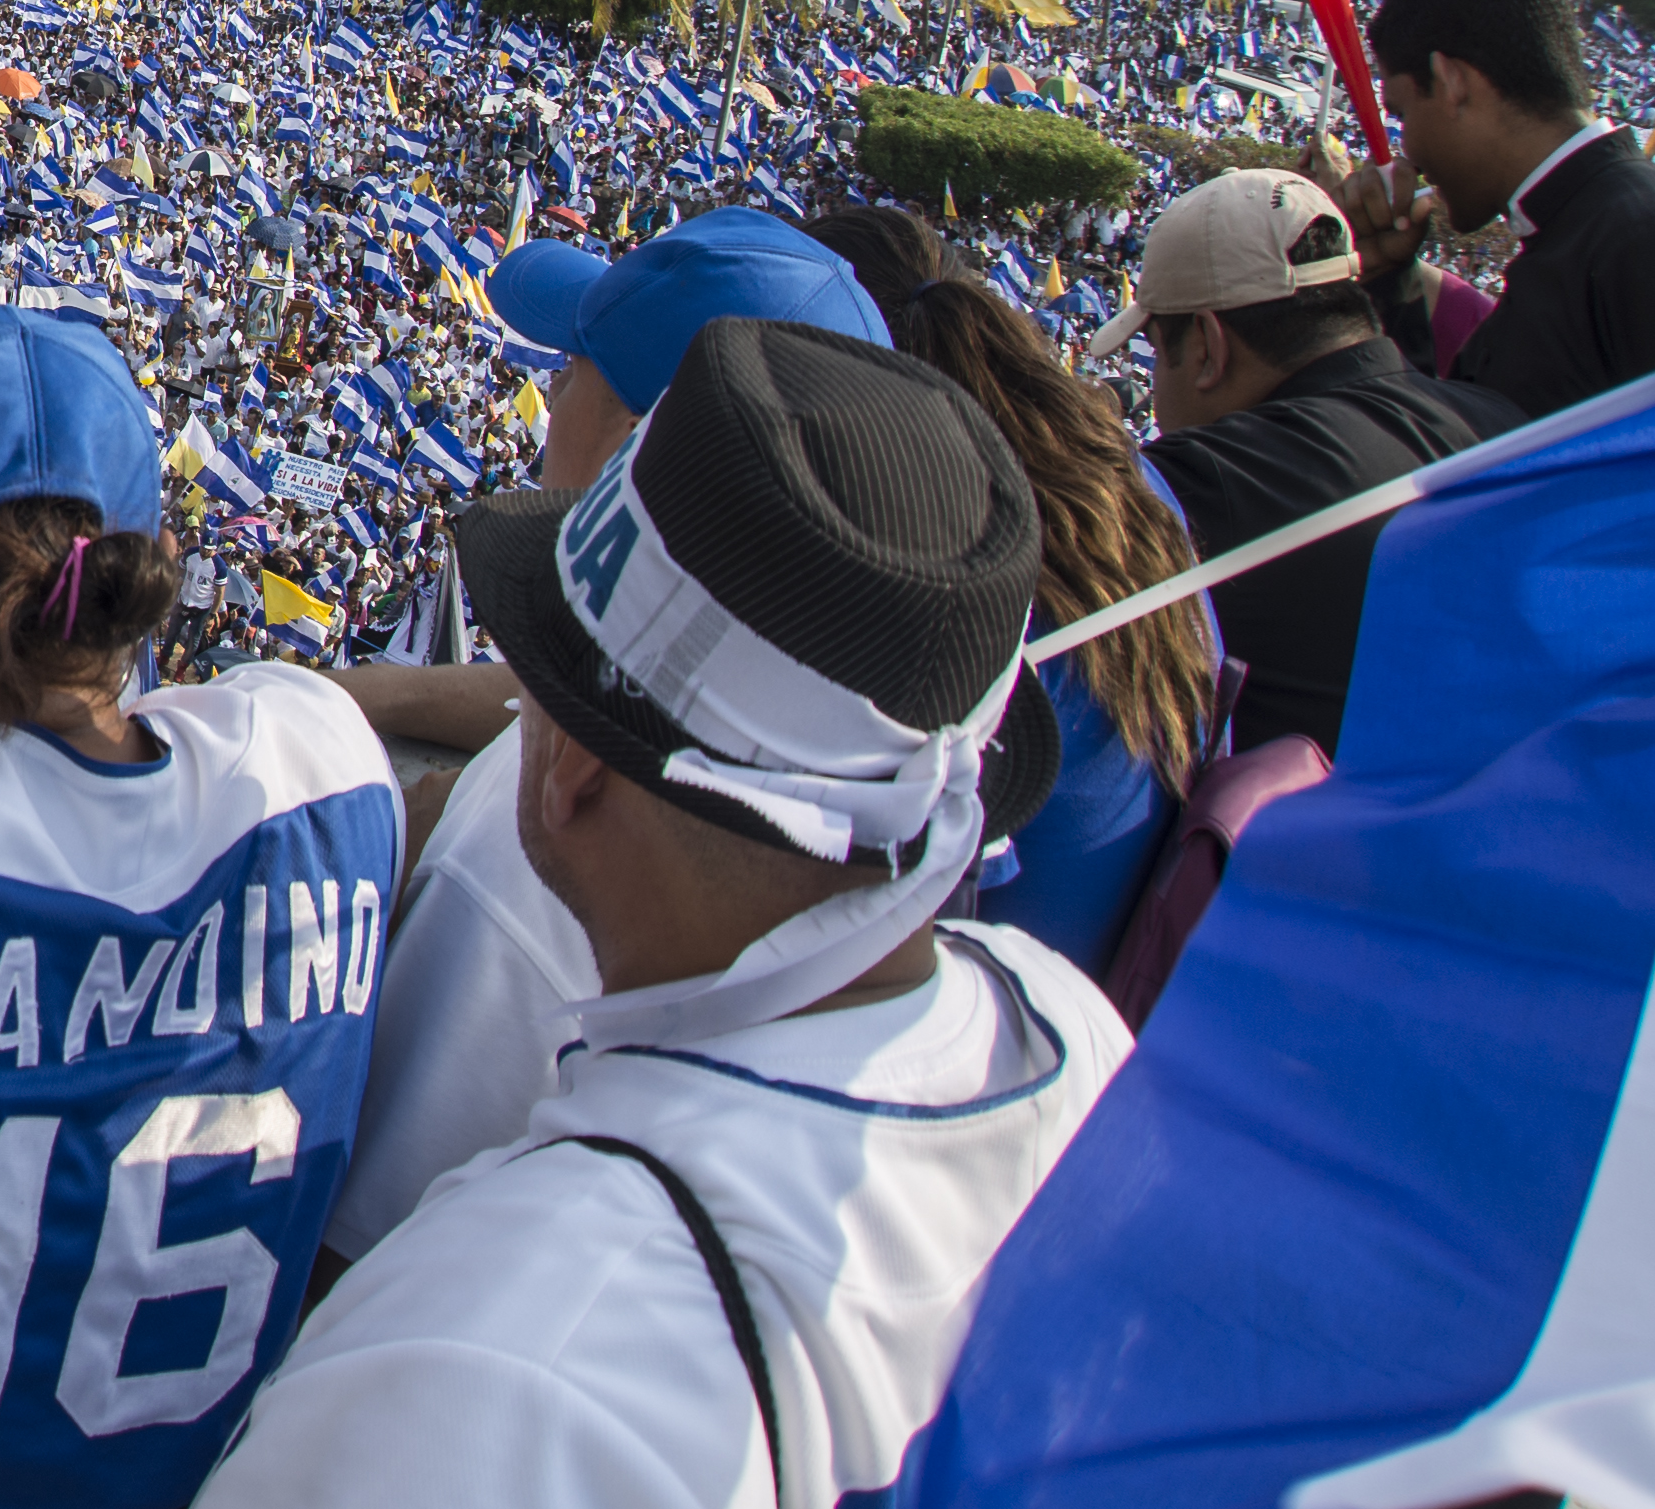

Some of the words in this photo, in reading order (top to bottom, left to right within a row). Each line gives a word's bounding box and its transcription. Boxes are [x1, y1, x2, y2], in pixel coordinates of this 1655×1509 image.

[288, 455, 323, 470] NUESTRO
[285, 463, 321, 478] NECESITA
[327, 474, 342, 484] PAZ
[290, 473, 297, 482] A
[301, 476, 314, 486] LA
[317, 479, 338, 493] VIDA
[272, 479, 286, 487] UEN
[290, 484, 335, 501] PRESIDENTE
[305, 496, 332, 508] PUEBLO
